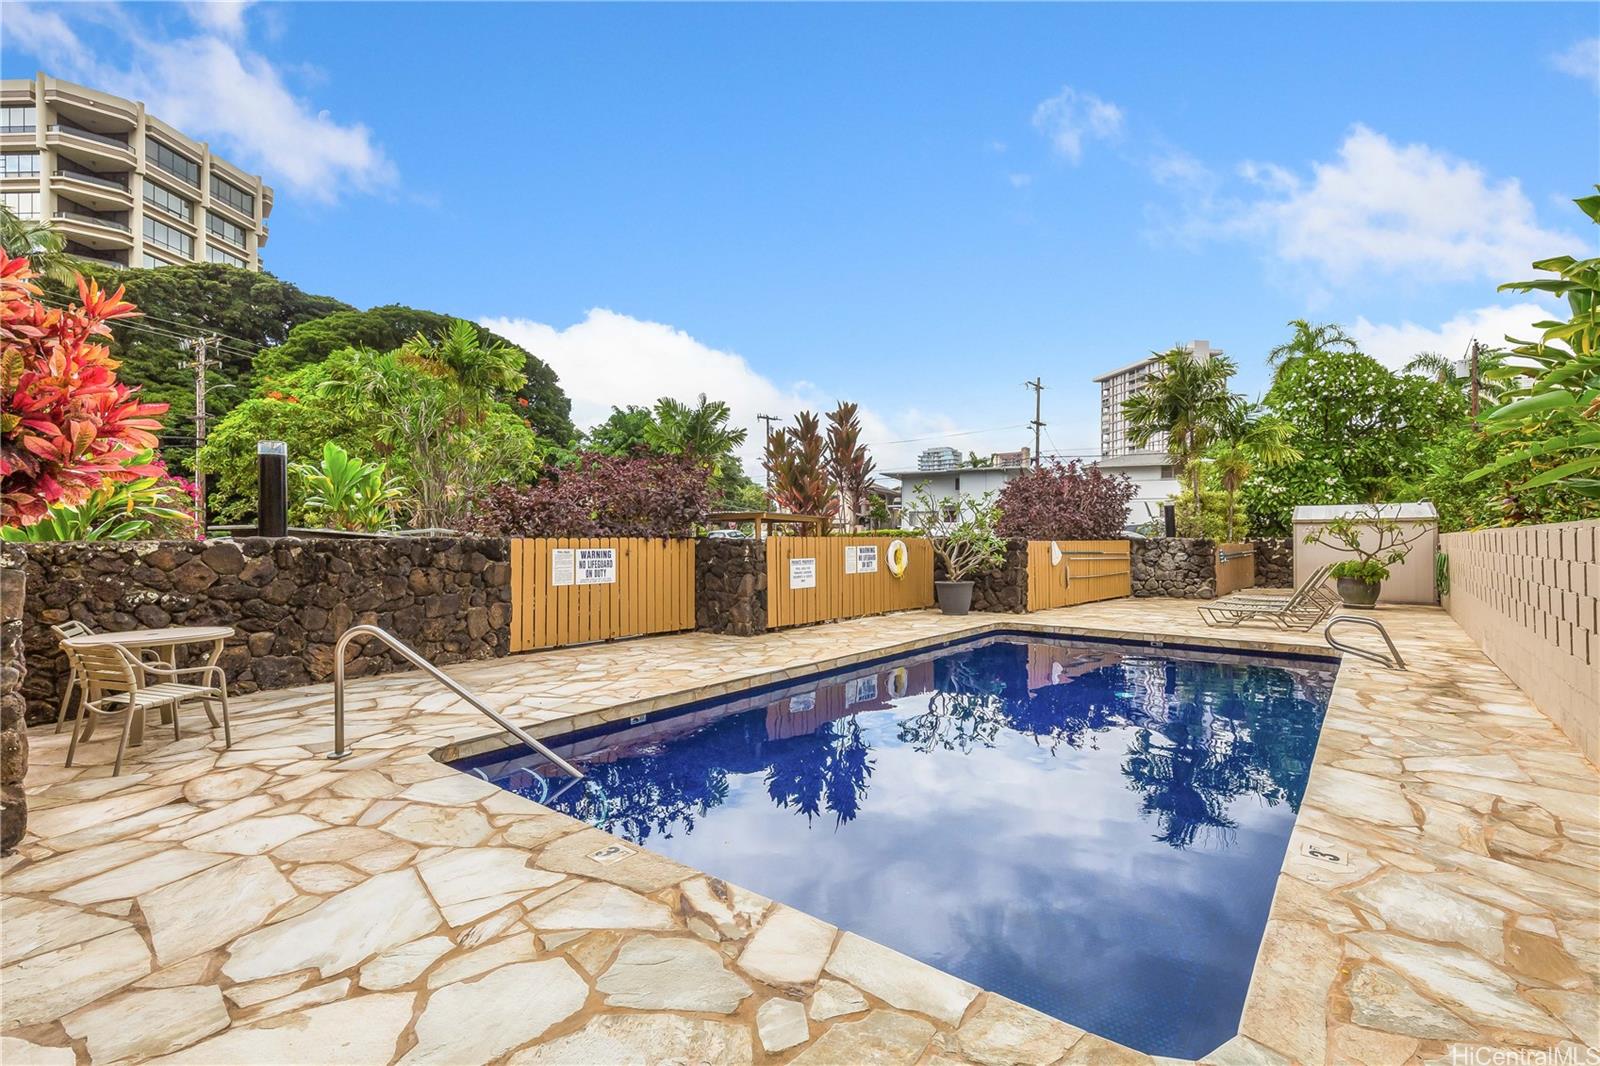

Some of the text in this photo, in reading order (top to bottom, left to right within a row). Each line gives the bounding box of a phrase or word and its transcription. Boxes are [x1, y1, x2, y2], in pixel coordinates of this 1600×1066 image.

[580, 550, 612, 560] WARNING
[579, 559, 613, 569] NO LIFEGUARD
[585, 569, 607, 578] ON DUTY
